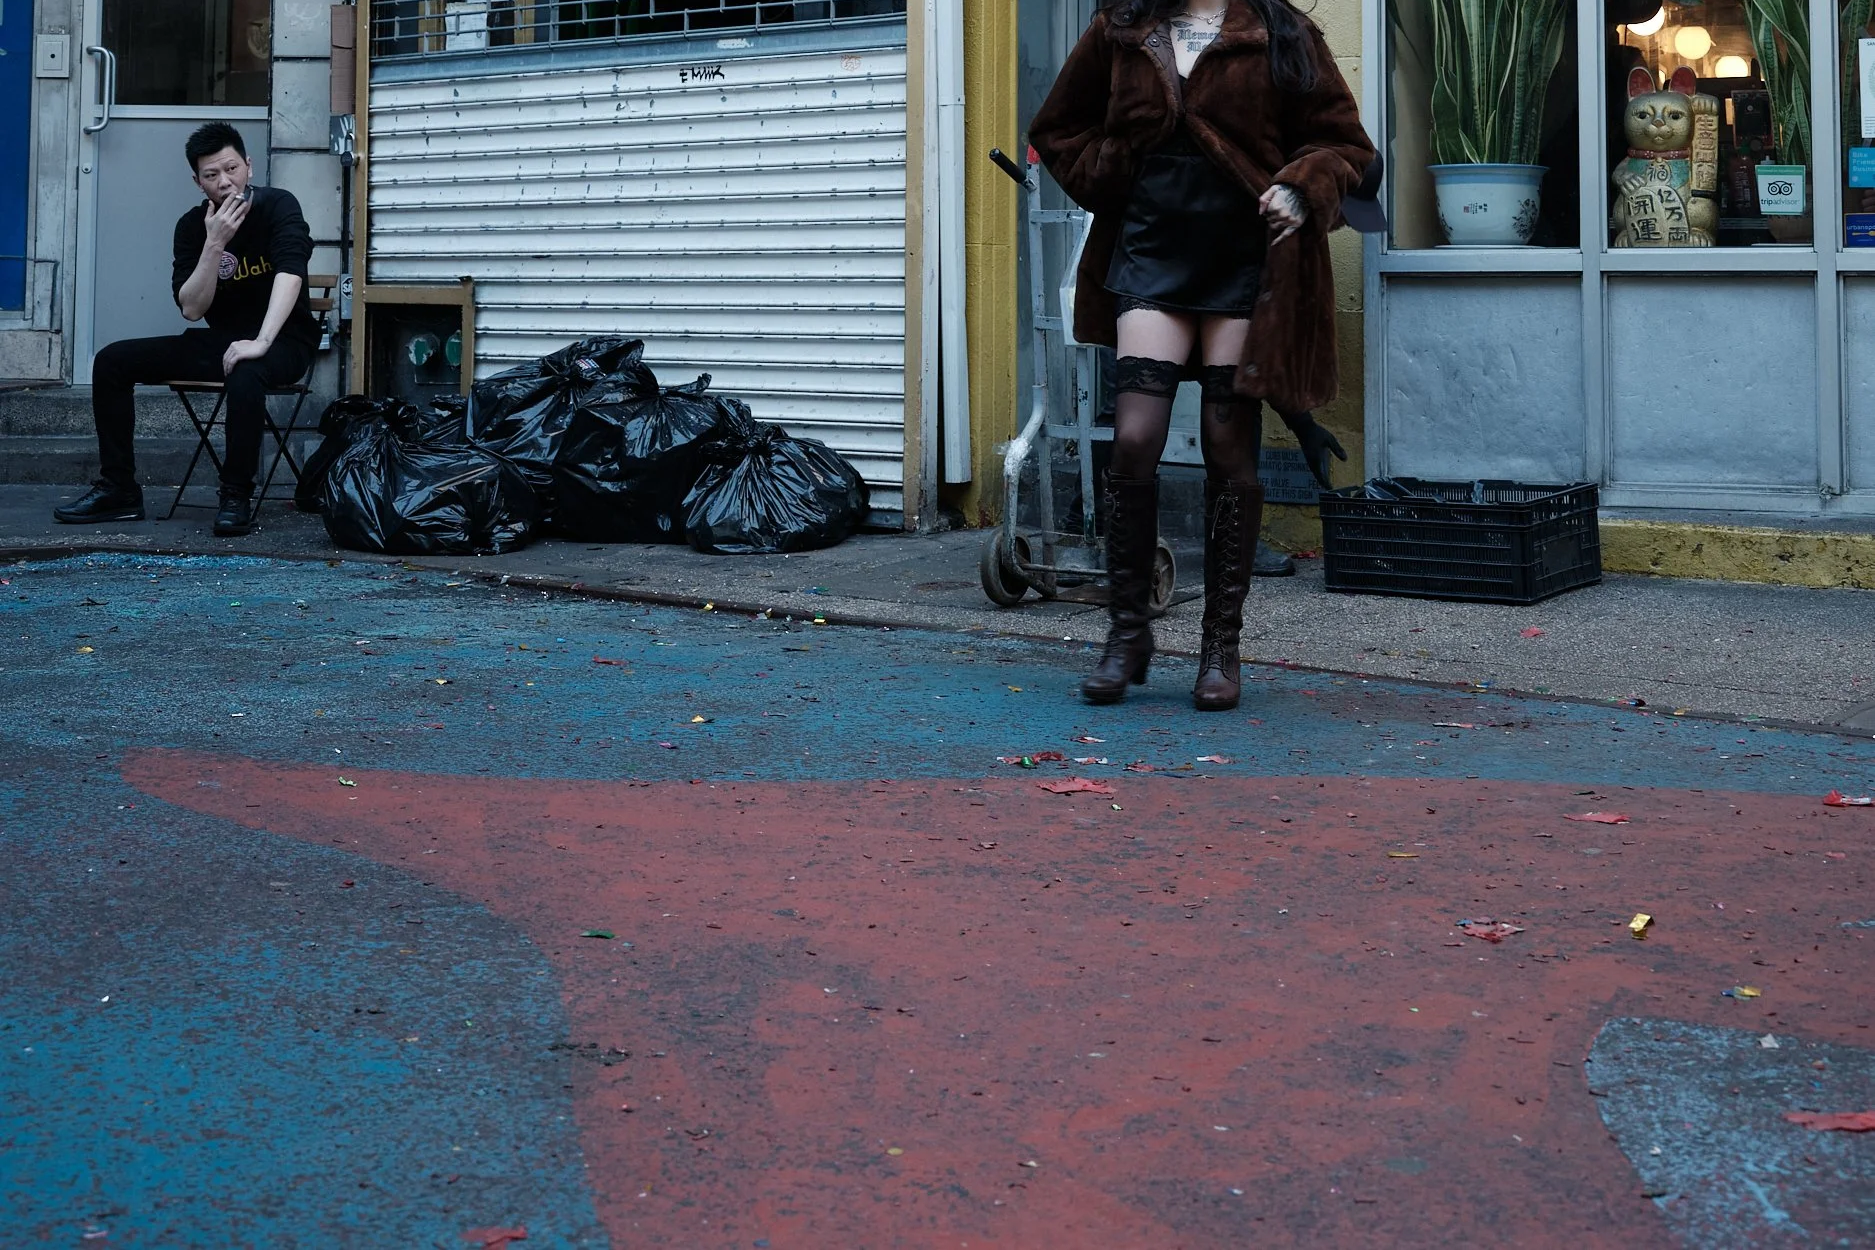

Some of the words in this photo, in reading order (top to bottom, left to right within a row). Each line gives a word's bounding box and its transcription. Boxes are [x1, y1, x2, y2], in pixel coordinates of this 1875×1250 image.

[1648, 163, 1670, 182] 福
[1761, 198, 1799, 206] tripadvisor
[1627, 195, 1662, 242] 開運
[233, 256, 273, 281] Wah
